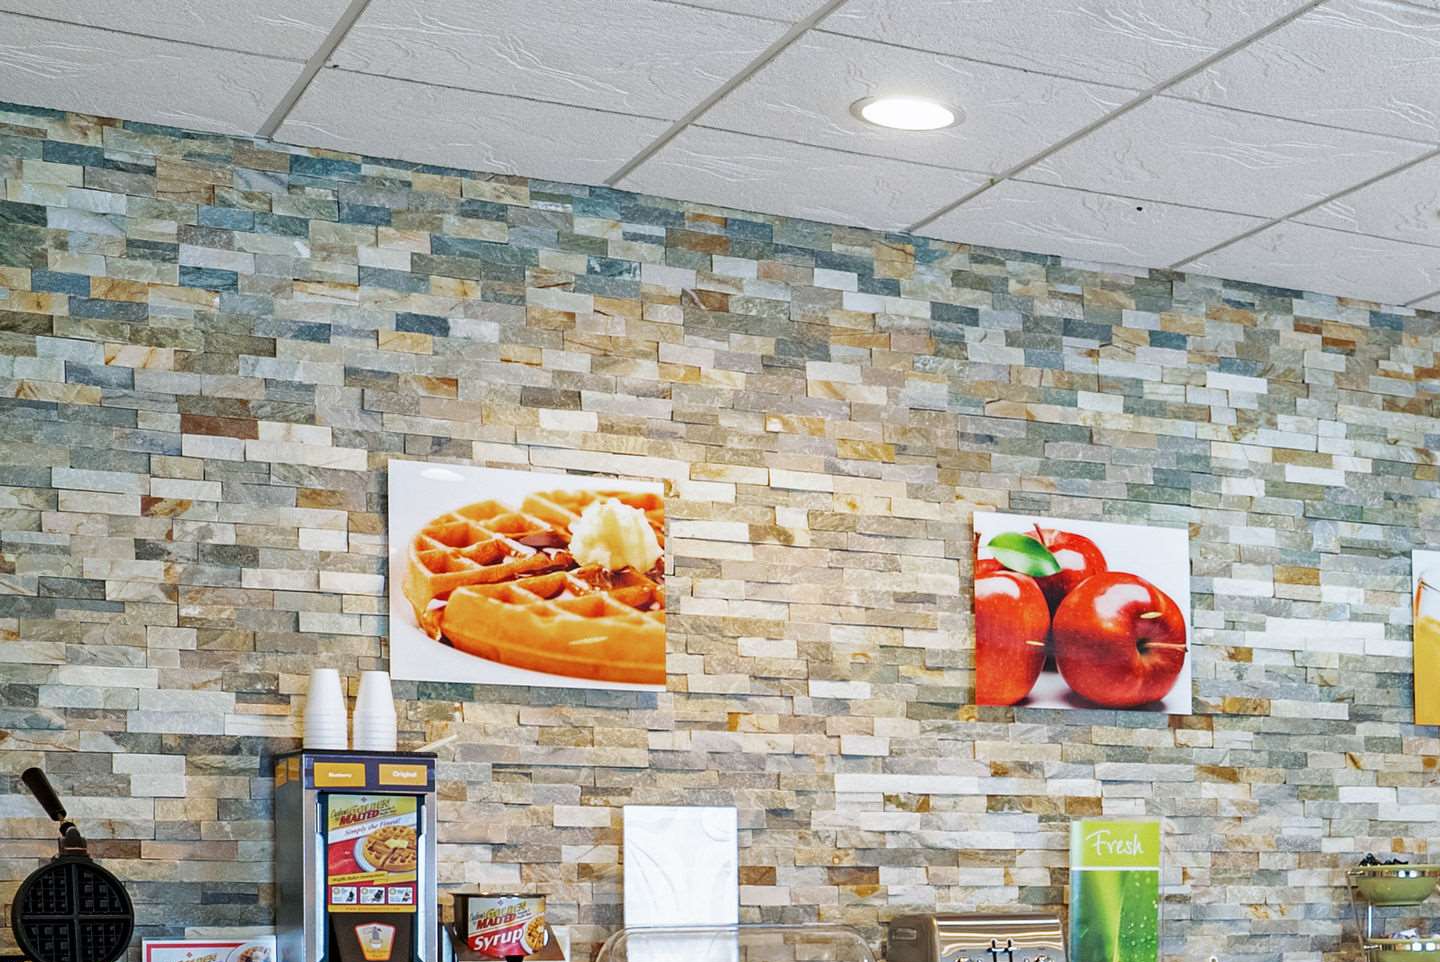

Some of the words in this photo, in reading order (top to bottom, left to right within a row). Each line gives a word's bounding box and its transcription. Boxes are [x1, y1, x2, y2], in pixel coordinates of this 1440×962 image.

[340, 809, 380, 825] MALTED
[1085, 829, 1145, 856] Fresh
[476, 913, 516, 930] MALTED
[473, 928, 523, 951] Syrup
